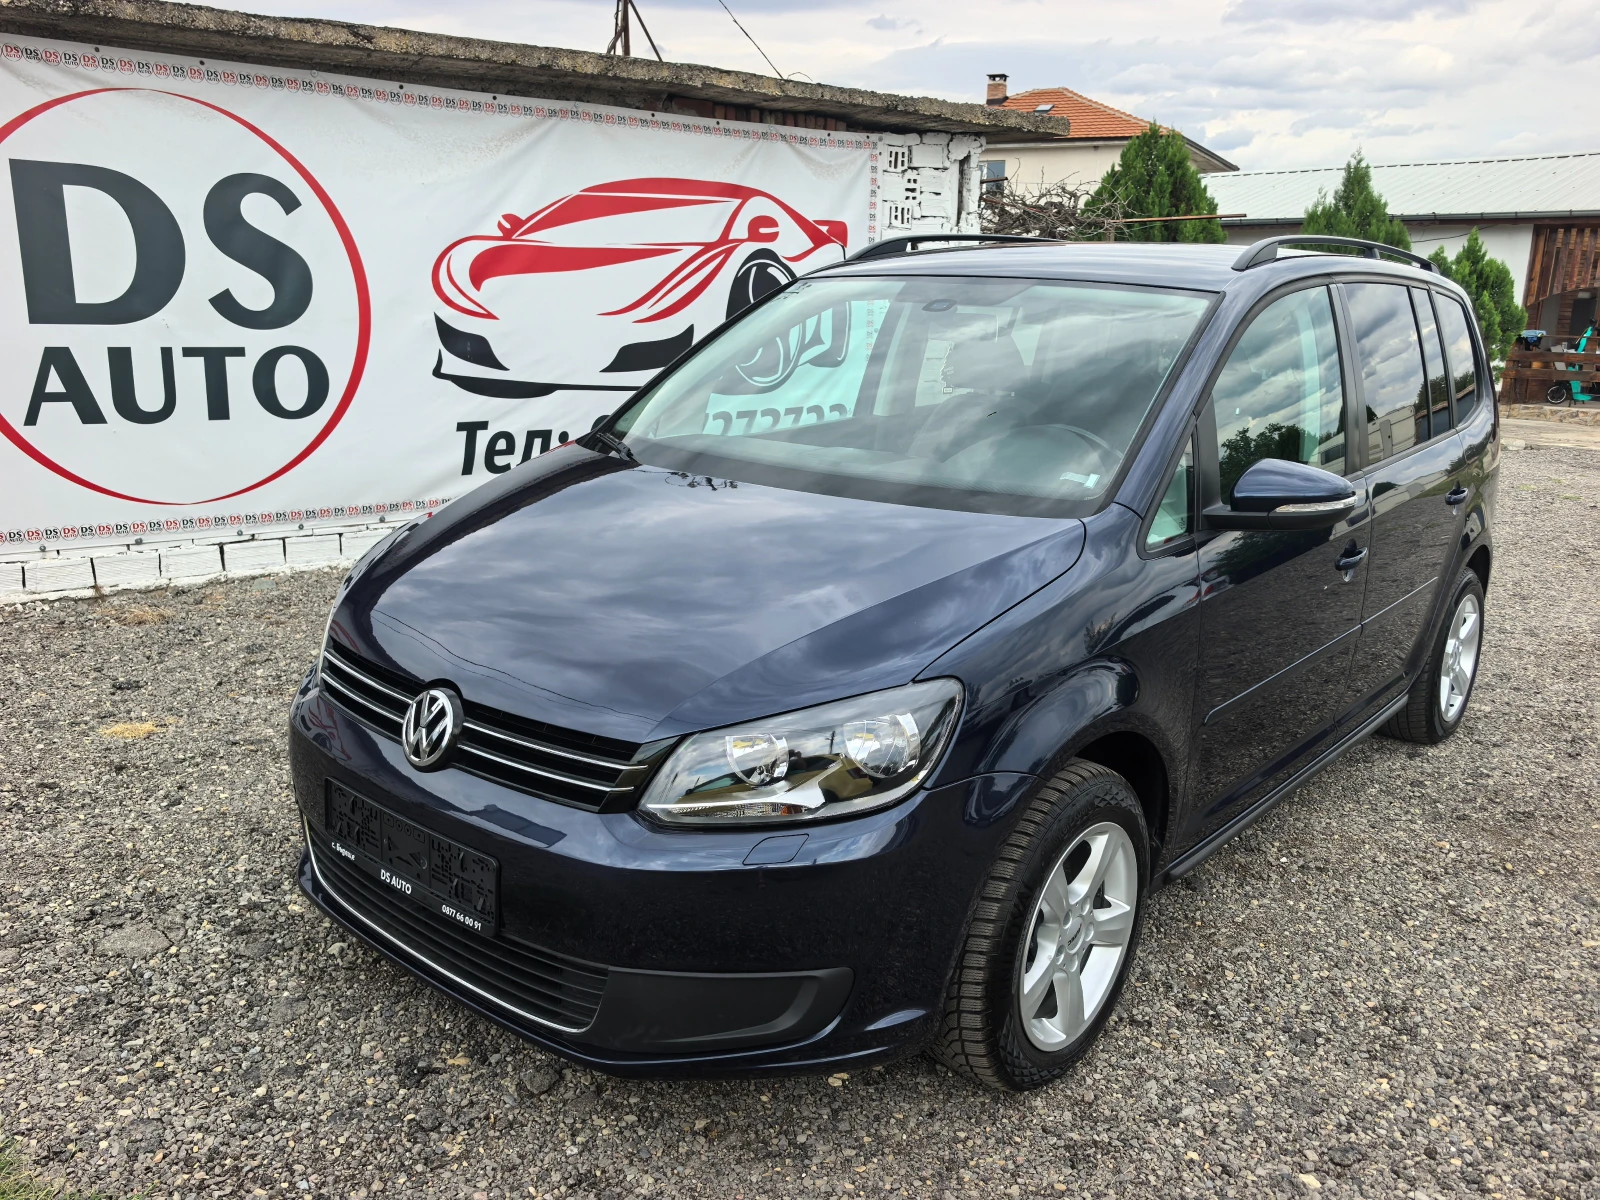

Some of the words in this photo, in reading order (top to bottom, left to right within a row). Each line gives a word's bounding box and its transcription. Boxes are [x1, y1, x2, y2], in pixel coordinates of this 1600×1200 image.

[5, 45, 19, 54] DS
[25, 48, 39, 56] DS
[44, 50, 58, 59] DS
[64, 52, 77, 61] DS
[83, 55, 96, 63] DS
[101, 58, 114, 66] DS
[119, 59, 132, 67] DS
[9, 158, 313, 330] DS
[24, 345, 329, 426] AUTO
[380, 869, 390, 882] DS
[391, 875, 412, 894] AUTO
[442, 904, 456, 918] 0877
[456, 912, 464, 922] 66
[464, 916, 474, 926] 00
[474, 920, 482, 931] 91
